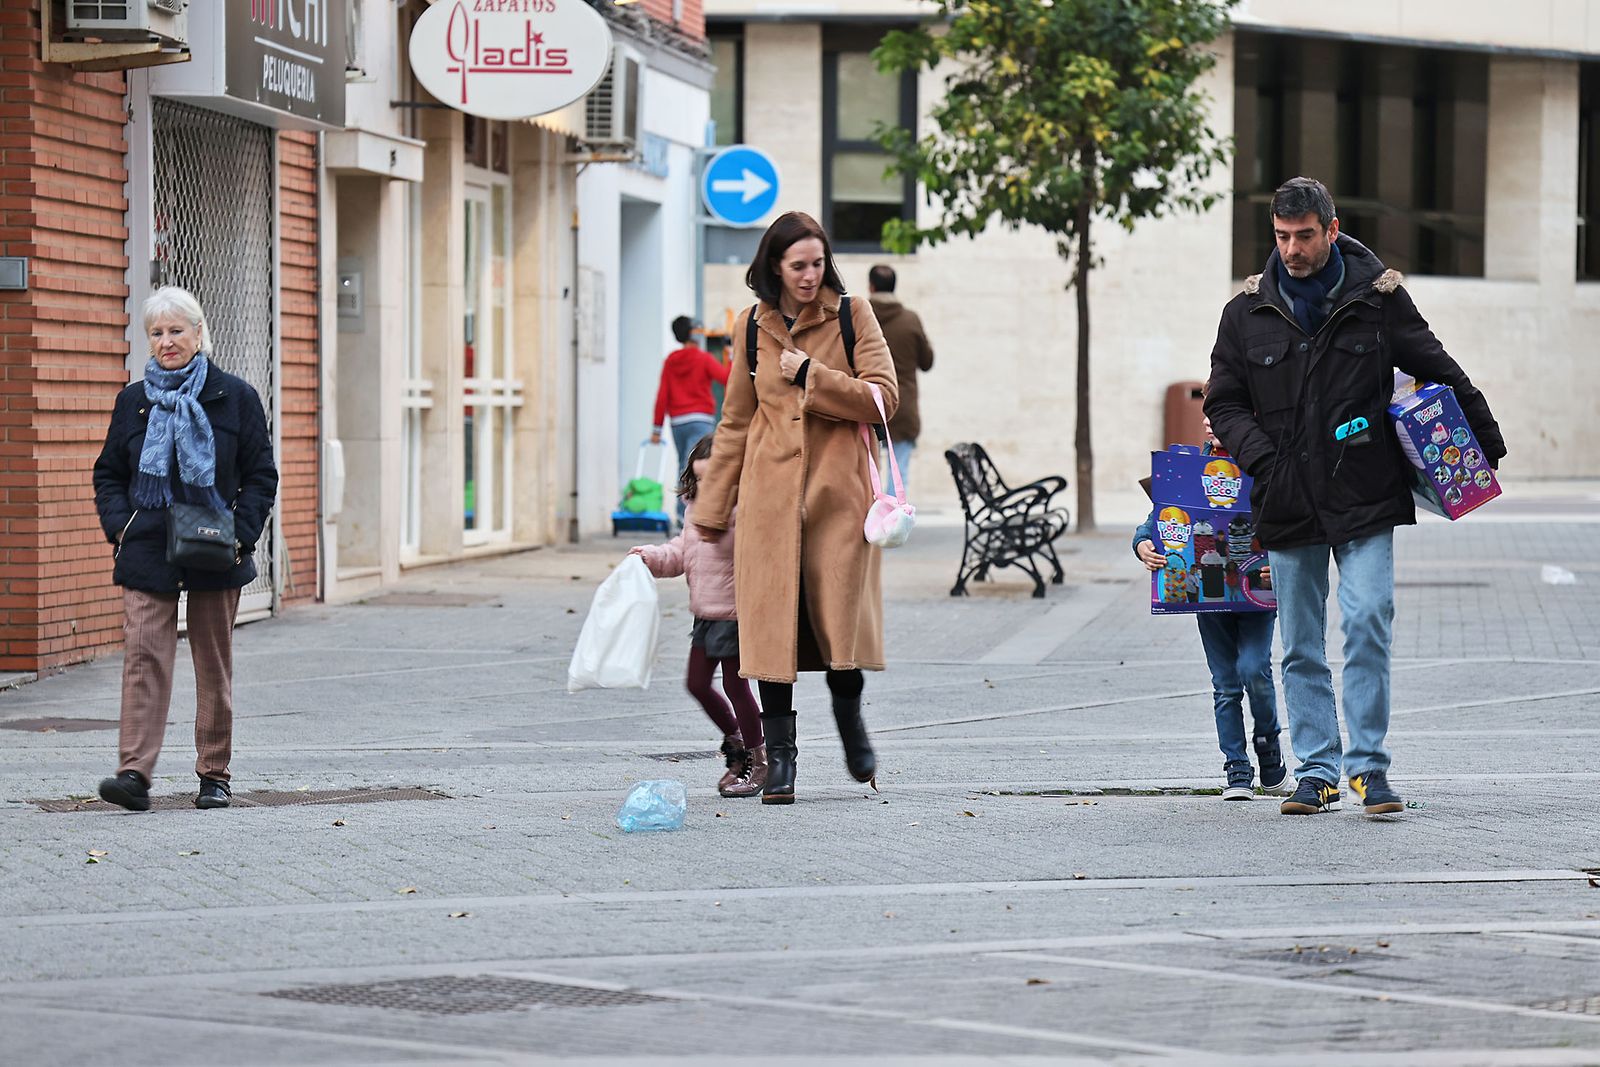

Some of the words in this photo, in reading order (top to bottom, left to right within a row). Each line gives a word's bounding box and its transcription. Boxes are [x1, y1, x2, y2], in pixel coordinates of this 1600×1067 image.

[262, 54, 316, 103] PELUQUERIA
[1202, 476, 1241, 490] Dormi
[1158, 521, 1191, 535] Dormi
